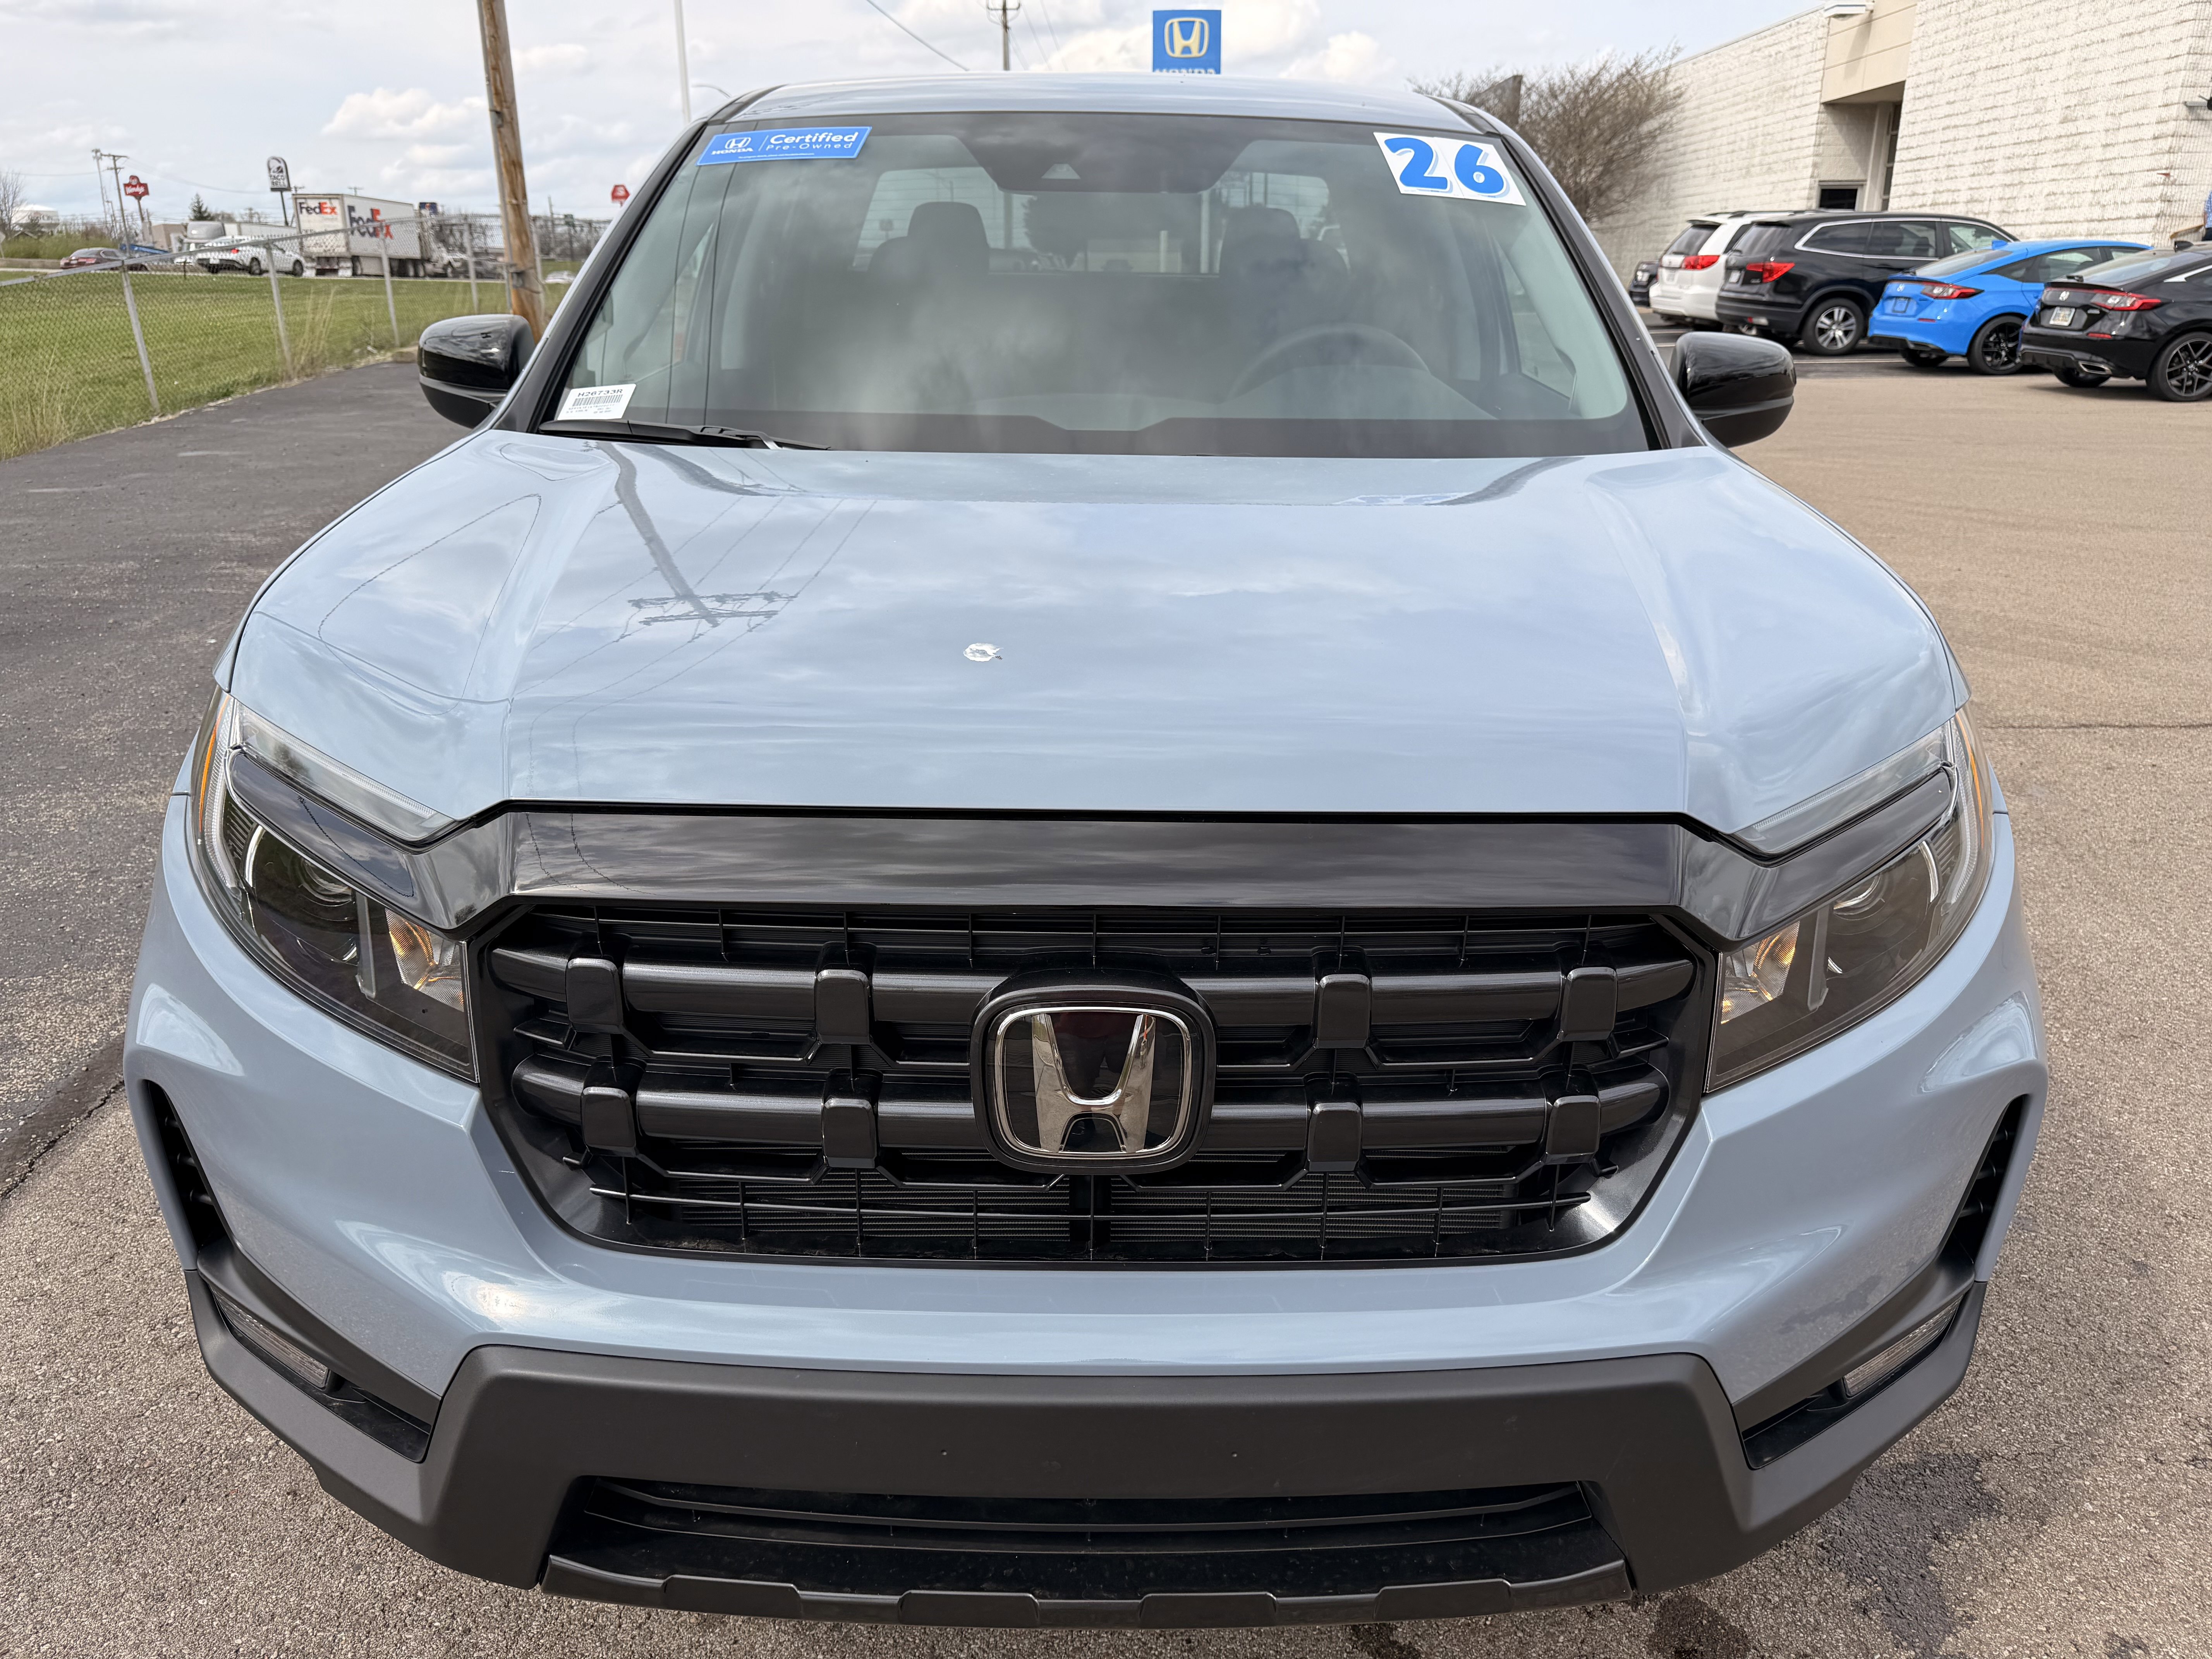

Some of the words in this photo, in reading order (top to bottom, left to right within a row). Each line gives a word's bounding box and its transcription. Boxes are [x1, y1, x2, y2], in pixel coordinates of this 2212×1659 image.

[769, 132, 859, 145] Certified
[765, 142, 853, 151] Pre-Owned
[1384, 137, 1504, 194] 26
[299, 202, 338, 215] FedEx
[577, 389, 623, 397] H26733R
